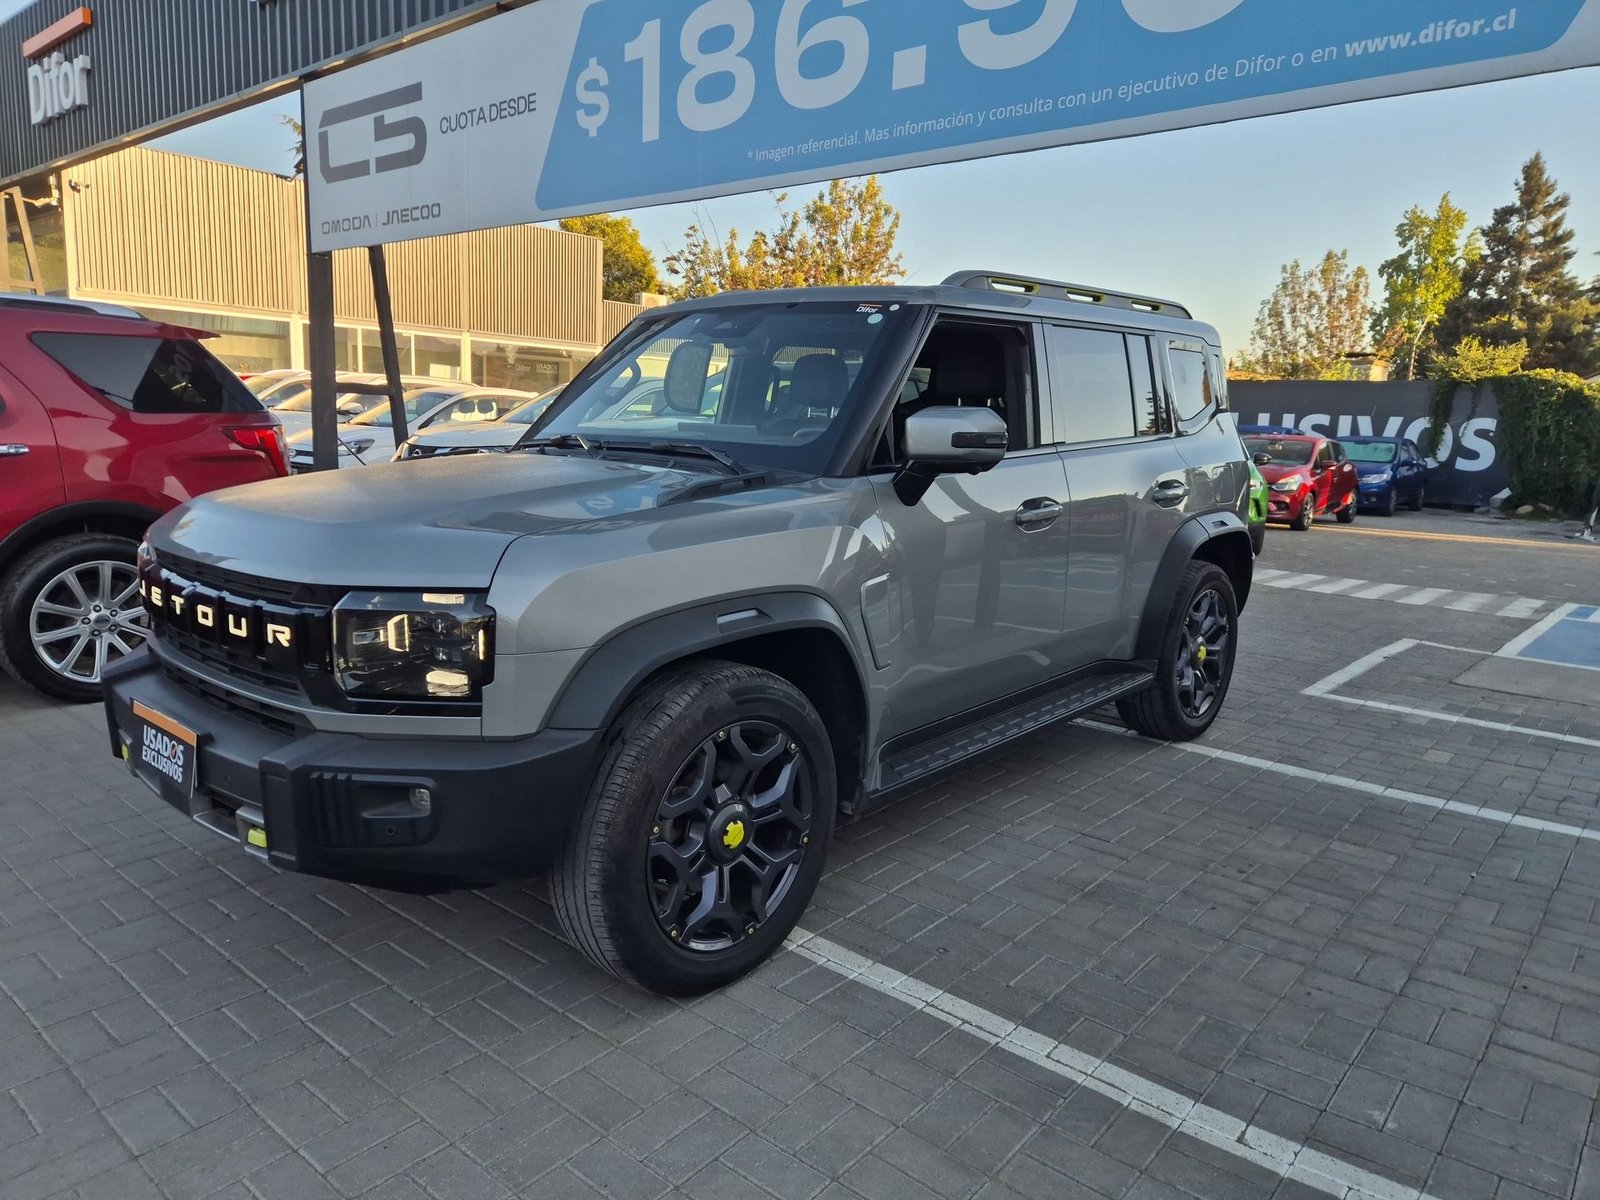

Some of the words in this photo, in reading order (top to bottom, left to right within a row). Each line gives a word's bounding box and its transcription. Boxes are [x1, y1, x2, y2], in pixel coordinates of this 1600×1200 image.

[27, 51, 91, 125] Difor
[755, 145, 794, 163] Imagen
[796, 132, 861, 154] referencial.
[864, 127, 890, 143] Mas
[893, 111, 973, 138] información
[977, 108, 986, 127] y
[989, 96, 1053, 120] consulta
[1057, 92, 1087, 110] con
[1091, 87, 1113, 103] un
[1117, 71, 1199, 102] ejecutivo
[1204, 63, 1228, 82] de
[1234, 53, 1287, 78] Difor
[1291, 52, 1304, 67] o
[1310, 45, 1338, 63] en
[1344, 8, 1517, 58] www.difor.cl
[439, 106, 487, 135] CUOTA
[488, 92, 537, 123] DESDE
[321, 214, 371, 235] OMODA
[381, 202, 442, 227] JAECOO
[139, 579, 291, 648] JETOUR
[141, 744, 183, 784] EXCLUSIVOS
[142, 724, 184, 763] USADOS
